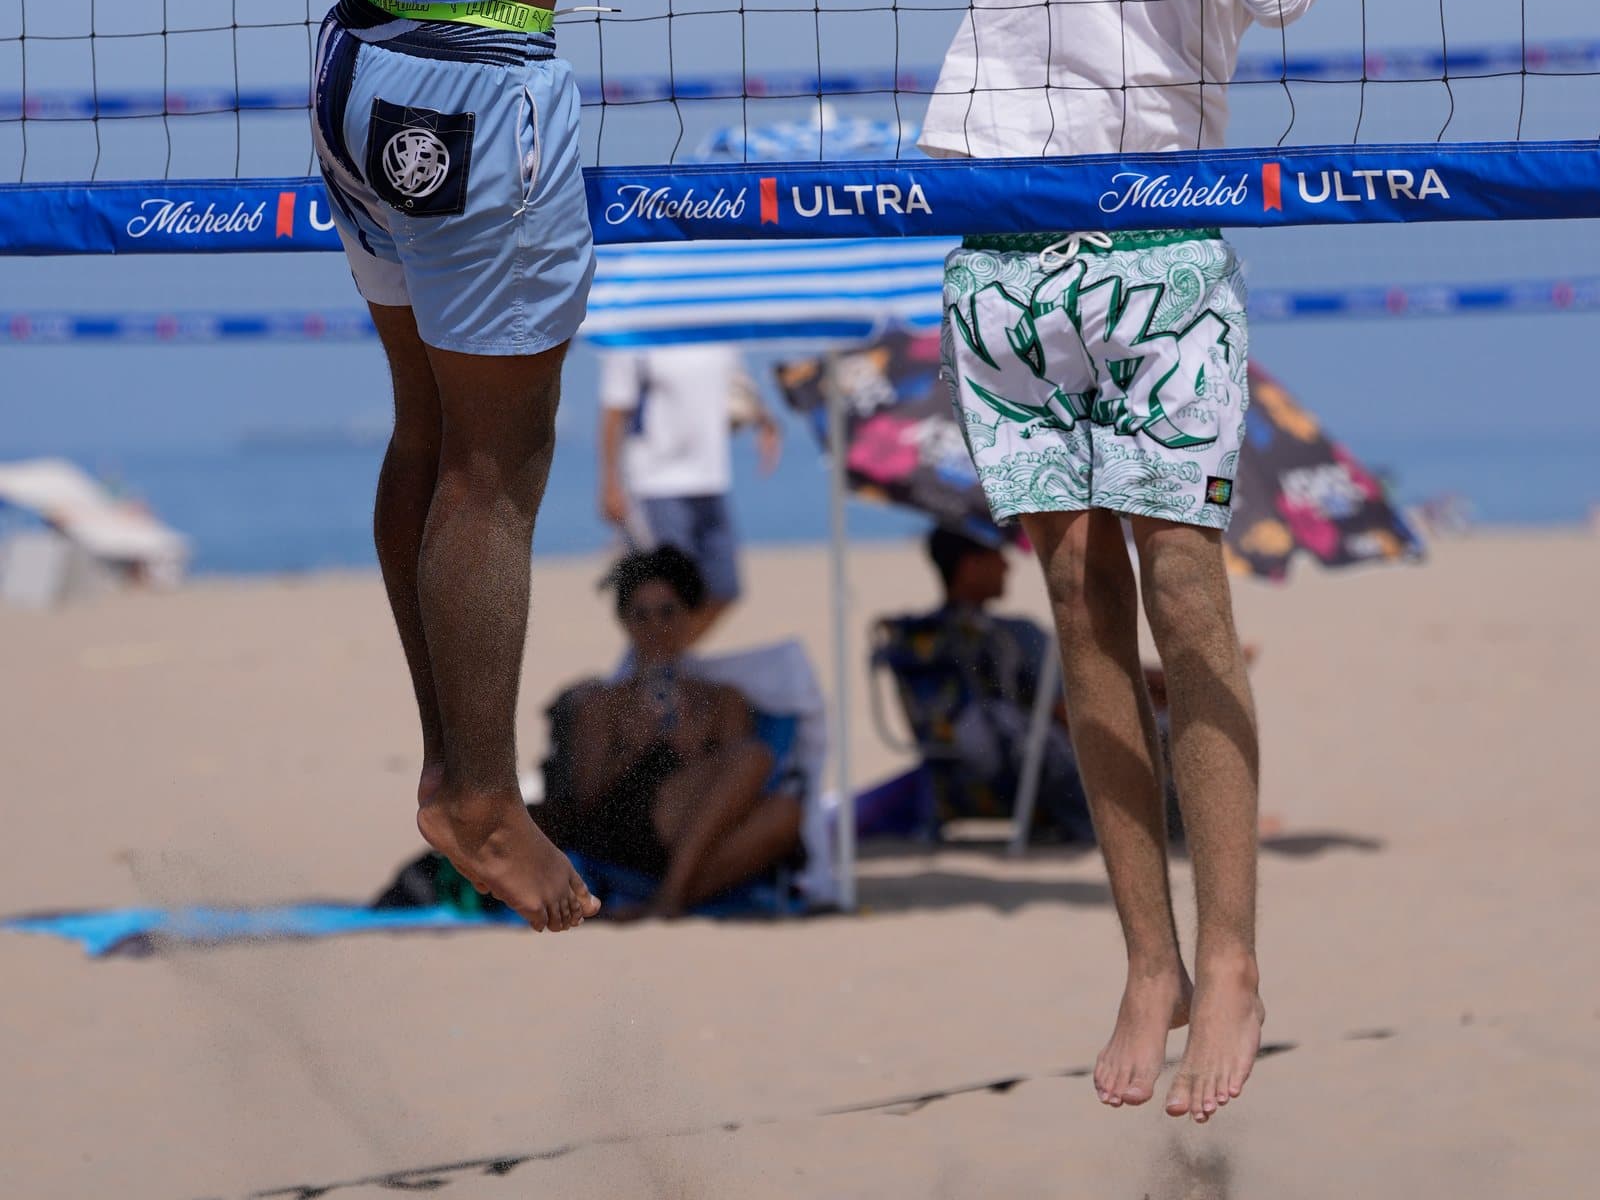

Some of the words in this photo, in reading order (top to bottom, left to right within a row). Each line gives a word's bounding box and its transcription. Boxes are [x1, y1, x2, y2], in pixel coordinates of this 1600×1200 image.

[466, 0, 529, 29] PUMA
[605, 184, 747, 225] Michelob
[791, 183, 933, 218] ULTRA
[1098, 172, 1249, 213] Michelob
[1297, 168, 1450, 203] ULTRA
[126, 198, 267, 238] Michelob
